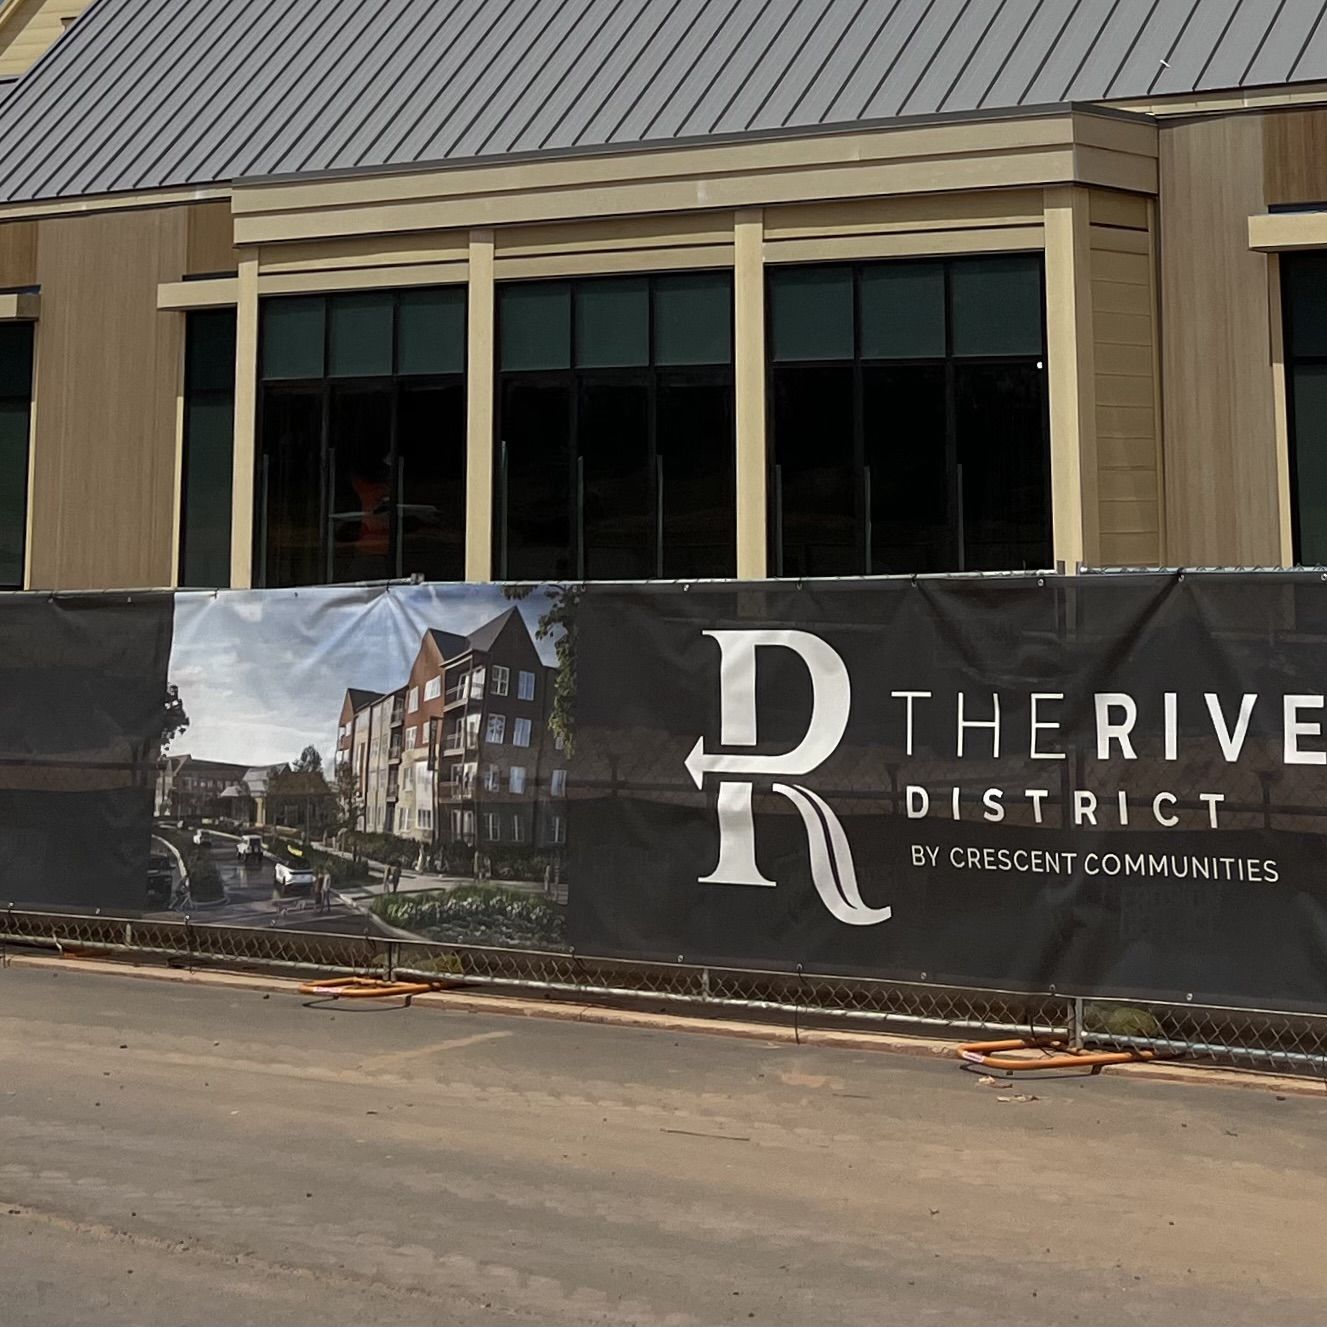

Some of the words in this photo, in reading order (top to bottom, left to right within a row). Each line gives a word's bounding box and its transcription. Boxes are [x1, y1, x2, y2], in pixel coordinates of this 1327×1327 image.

[891, 690, 1067, 760] THE
[906, 785, 1226, 829] DISTRICT
[911, 844, 941, 868] BY
[949, 846, 1079, 876] CRESCENT
[1083, 852, 1280, 884] COMMUNITIES
